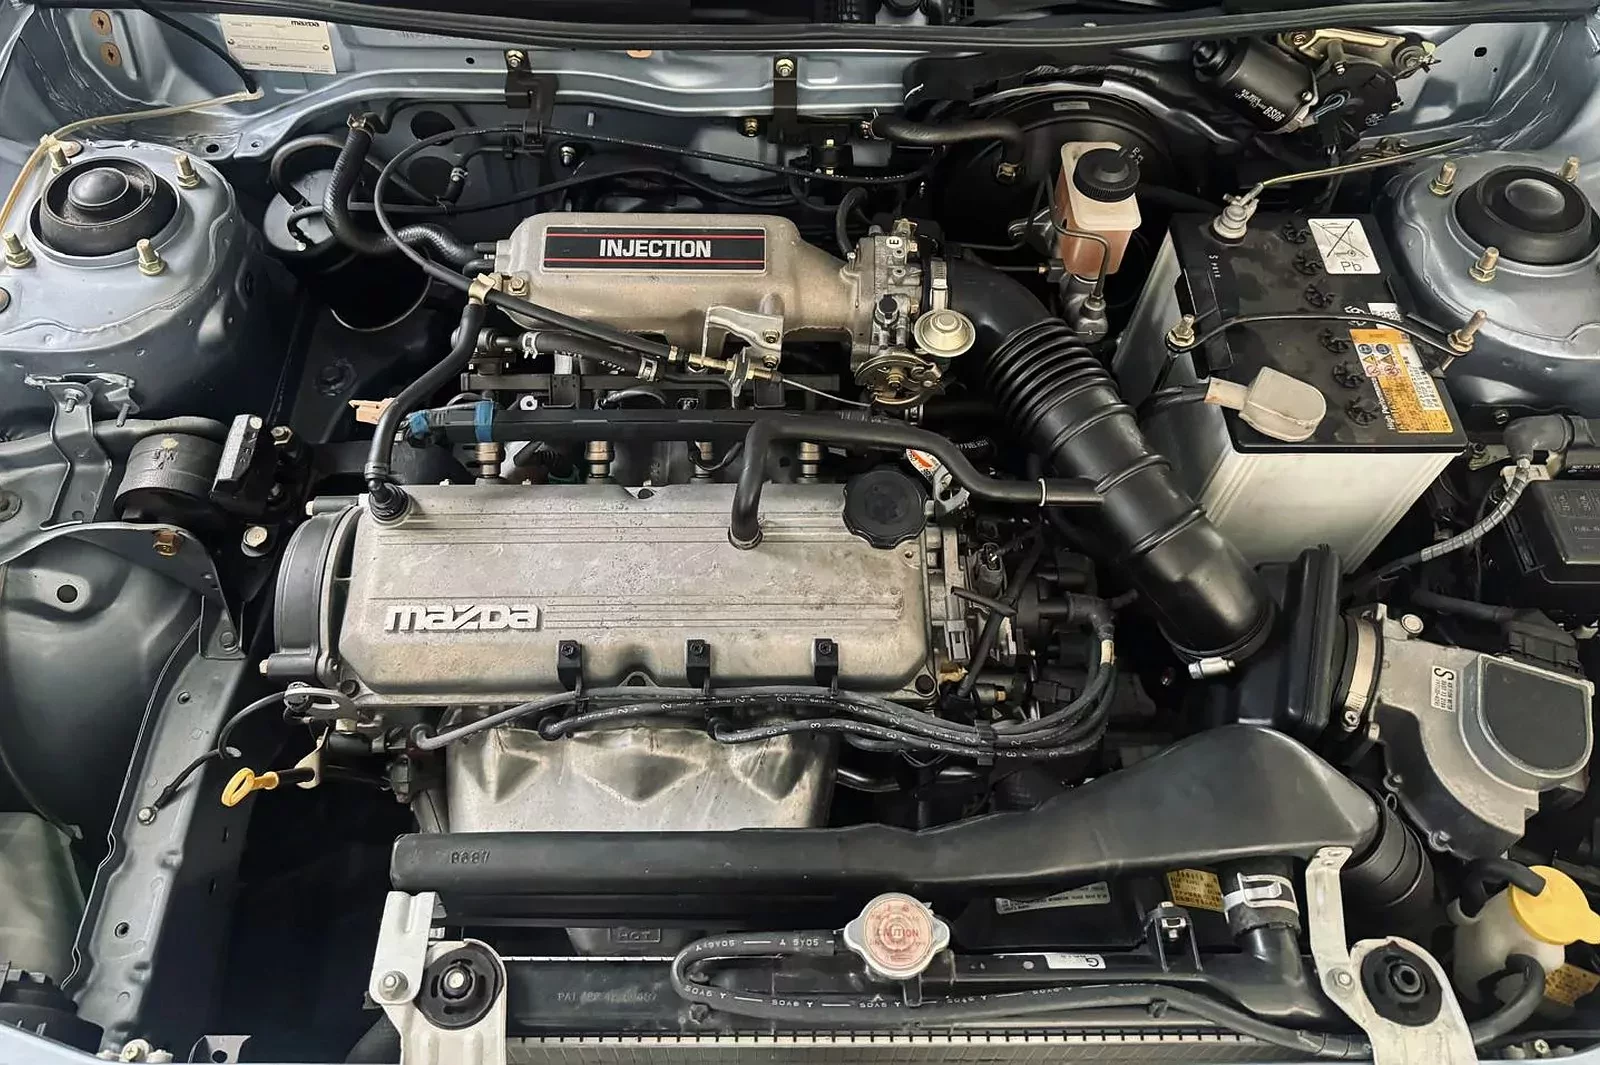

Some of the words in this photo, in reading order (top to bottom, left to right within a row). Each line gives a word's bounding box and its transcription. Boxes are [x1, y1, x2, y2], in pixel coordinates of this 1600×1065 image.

[600, 238, 711, 258] INJECTION
[1340, 261, 1362, 272] Pb
[384, 604, 540, 631] mazda
[1433, 667, 1455, 681] S
